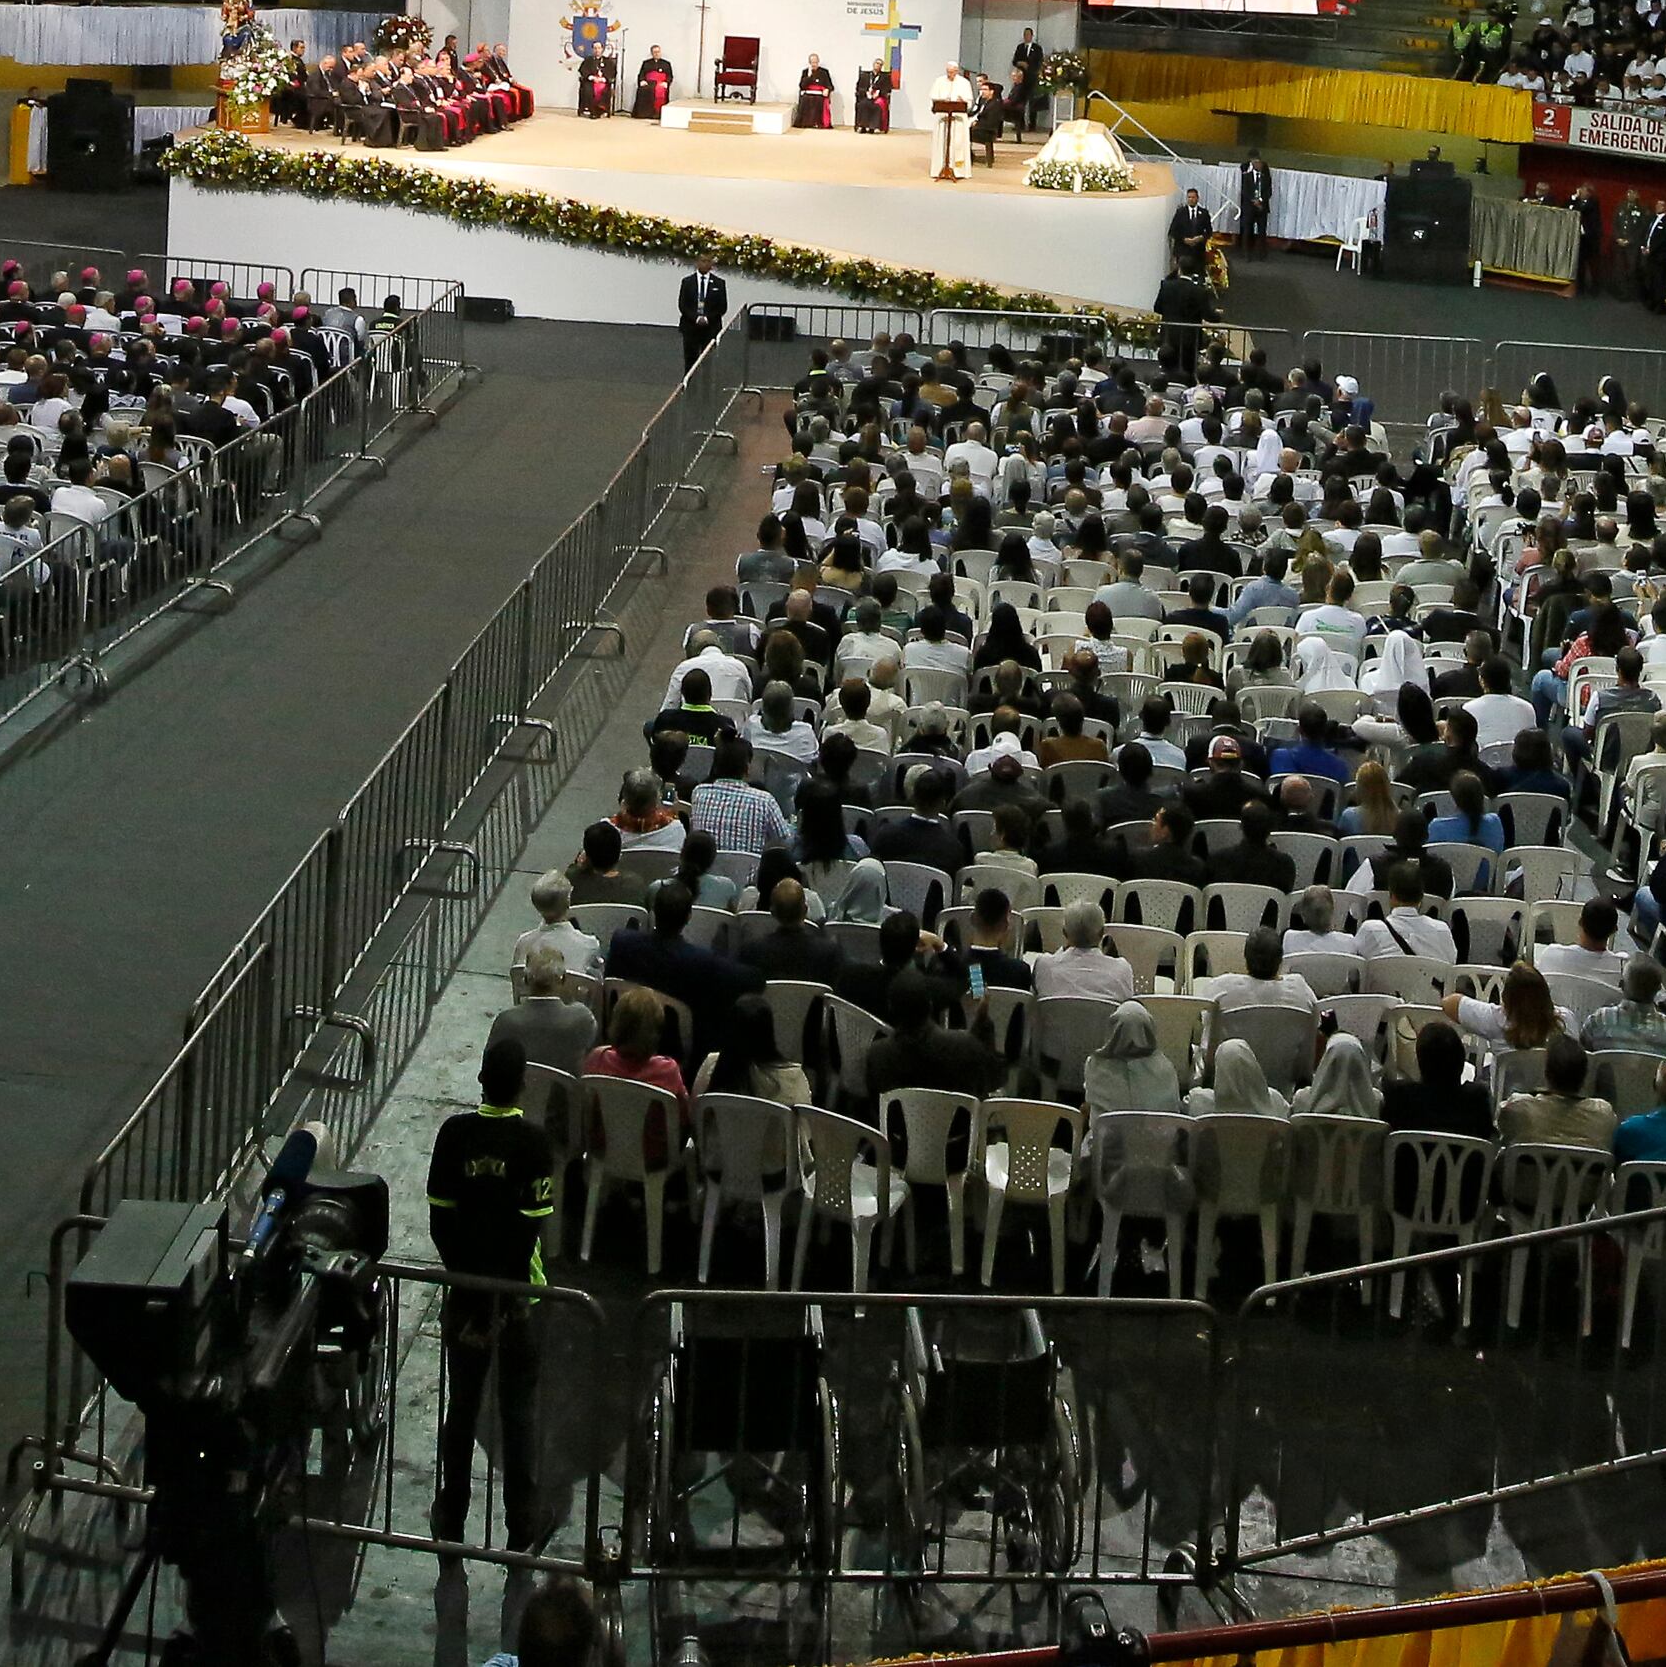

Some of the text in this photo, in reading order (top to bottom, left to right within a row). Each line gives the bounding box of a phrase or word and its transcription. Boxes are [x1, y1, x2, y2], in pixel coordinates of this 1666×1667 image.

[1543, 109, 1555, 125] 2
[1590, 112, 1664, 136] SALIDA DE
[530, 1176, 552, 1202] 12
